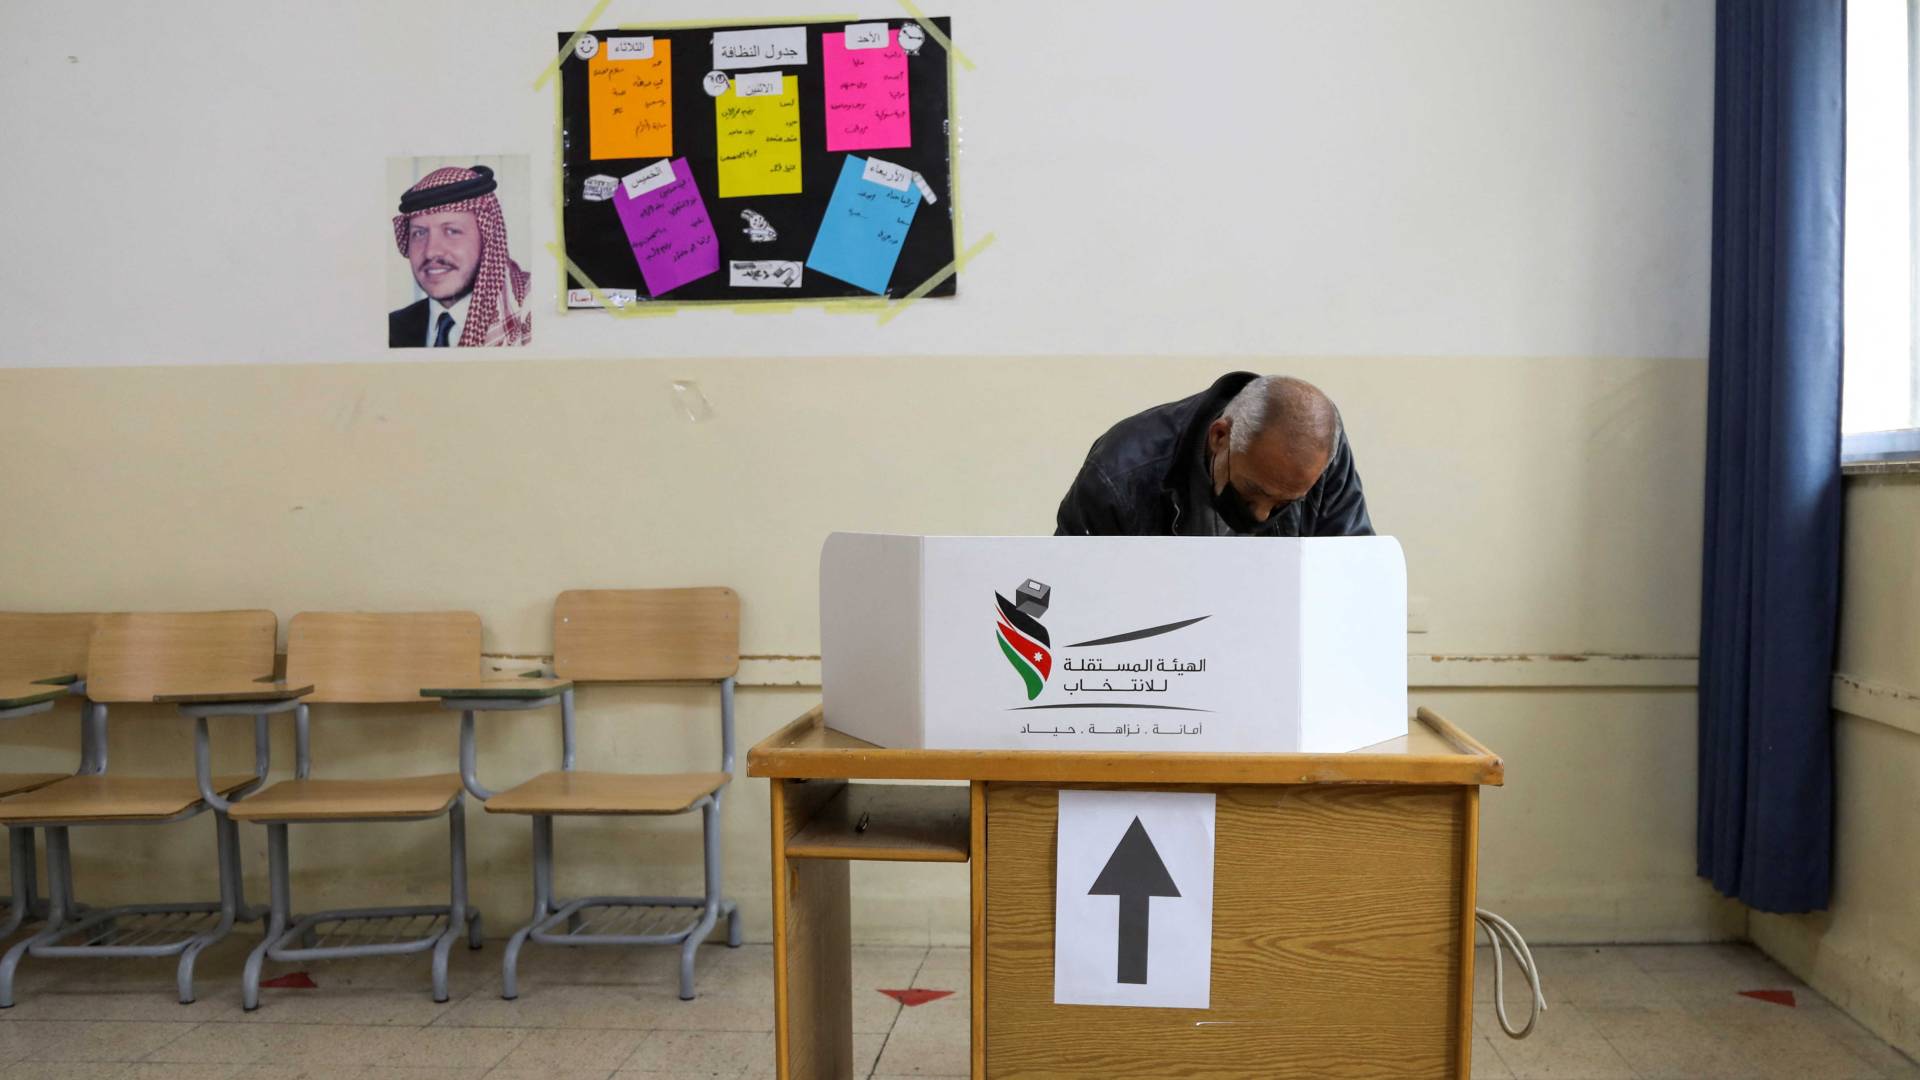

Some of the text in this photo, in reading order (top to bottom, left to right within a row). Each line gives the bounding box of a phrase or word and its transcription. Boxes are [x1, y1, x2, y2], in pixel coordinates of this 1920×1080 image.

[857, 31, 881, 43] الأحد
[614, 42, 645, 52] الثلاثاء
[721, 44, 799, 60] جدول النظافة
[631, 167, 662, 189] الخميس
[869, 164, 905, 182] الأربعاء
[1063, 658, 1206, 676] الهيئة المستقلة
[1063, 678, 1168, 695] للانتخاب
[1020, 721, 1202, 737] أمانة نزاهة حياد
